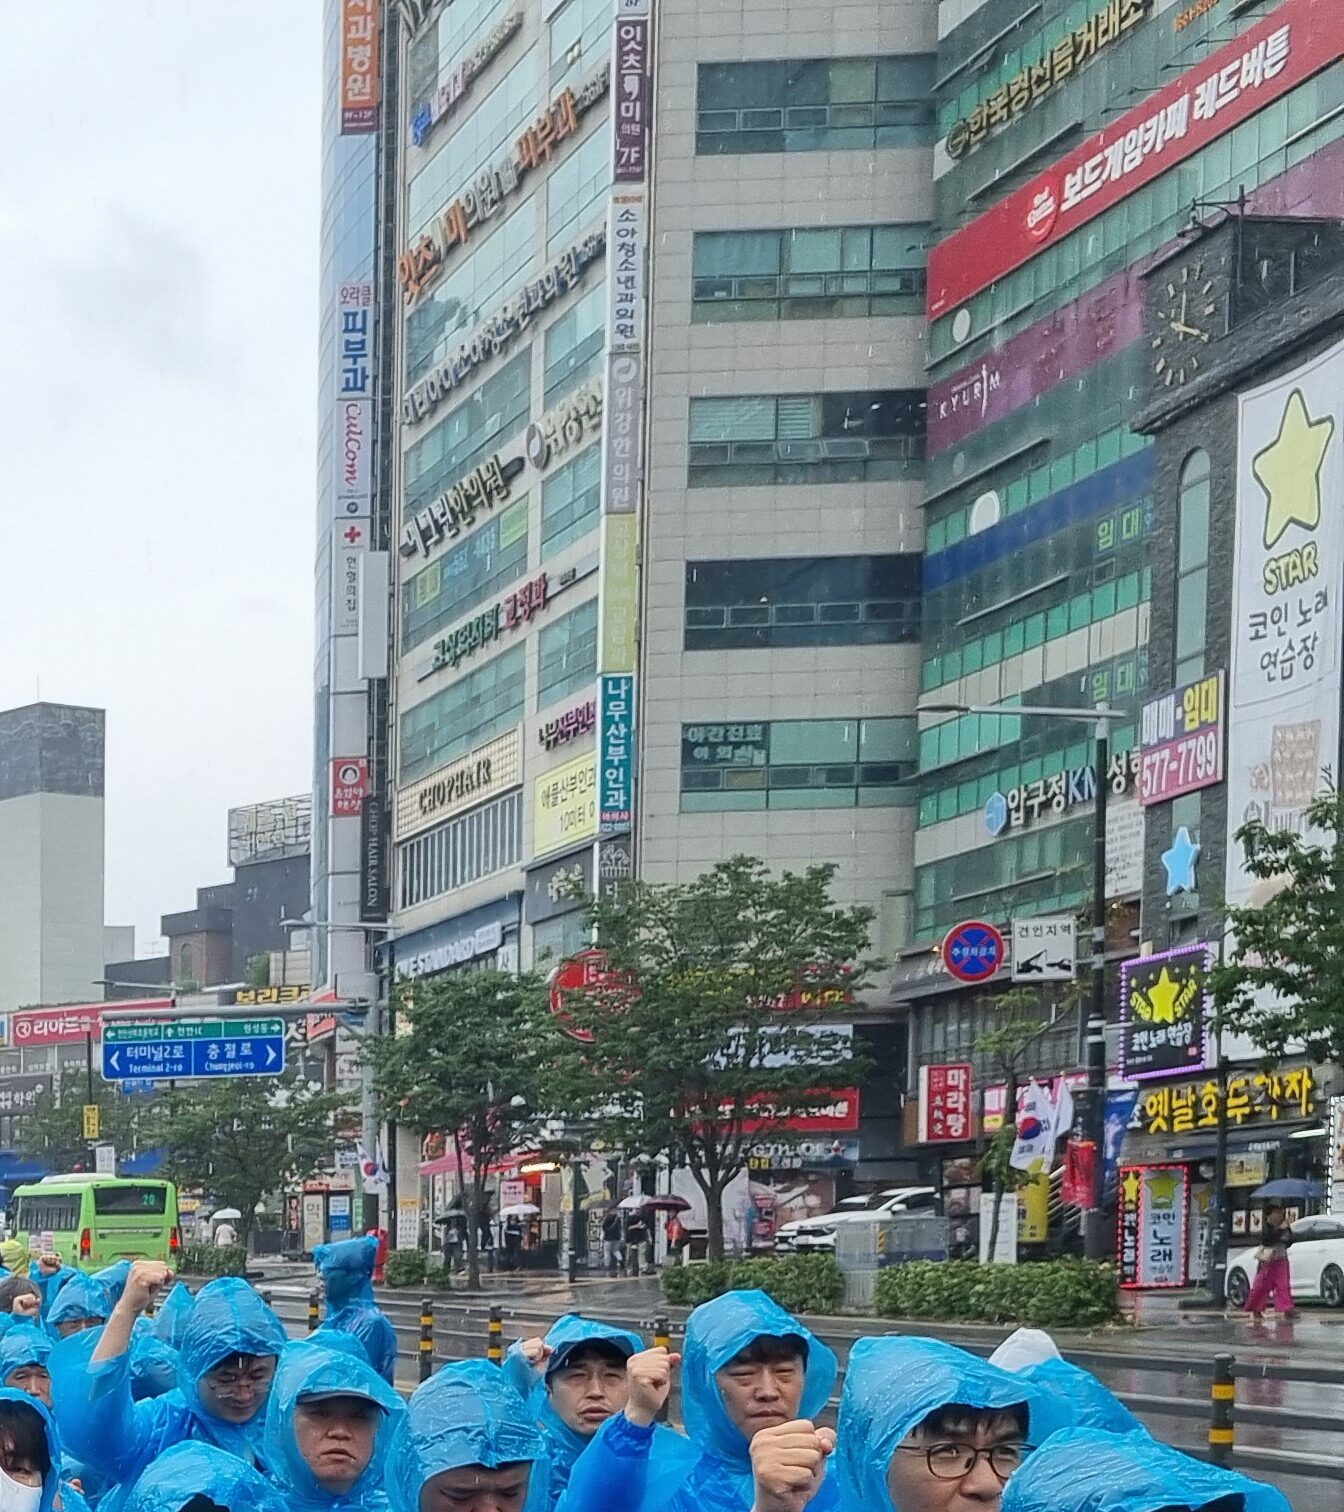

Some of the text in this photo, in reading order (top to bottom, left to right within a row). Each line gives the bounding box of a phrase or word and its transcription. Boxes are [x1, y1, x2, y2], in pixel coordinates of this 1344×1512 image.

[1060, 24, 1291, 213] 보드게임카페 레드버튼
[342, 310, 369, 392] 피부과
[1098, 509, 1140, 551] 임대
[1263, 542, 1318, 596] STAR
[1248, 602, 1289, 641] 코인
[1261, 631, 1318, 681] 연습장
[1093, 663, 1136, 700] 임대
[606, 679, 629, 810] 나무산부인과
[1142, 731, 1216, 797] 577-7799
[1018, 923, 1071, 938] 견인지역
[126, 1045, 185, 1062] 터미널2로
[129, 1064, 163, 1074] Terminal
[947, 1069, 967, 1137] 마라탕
